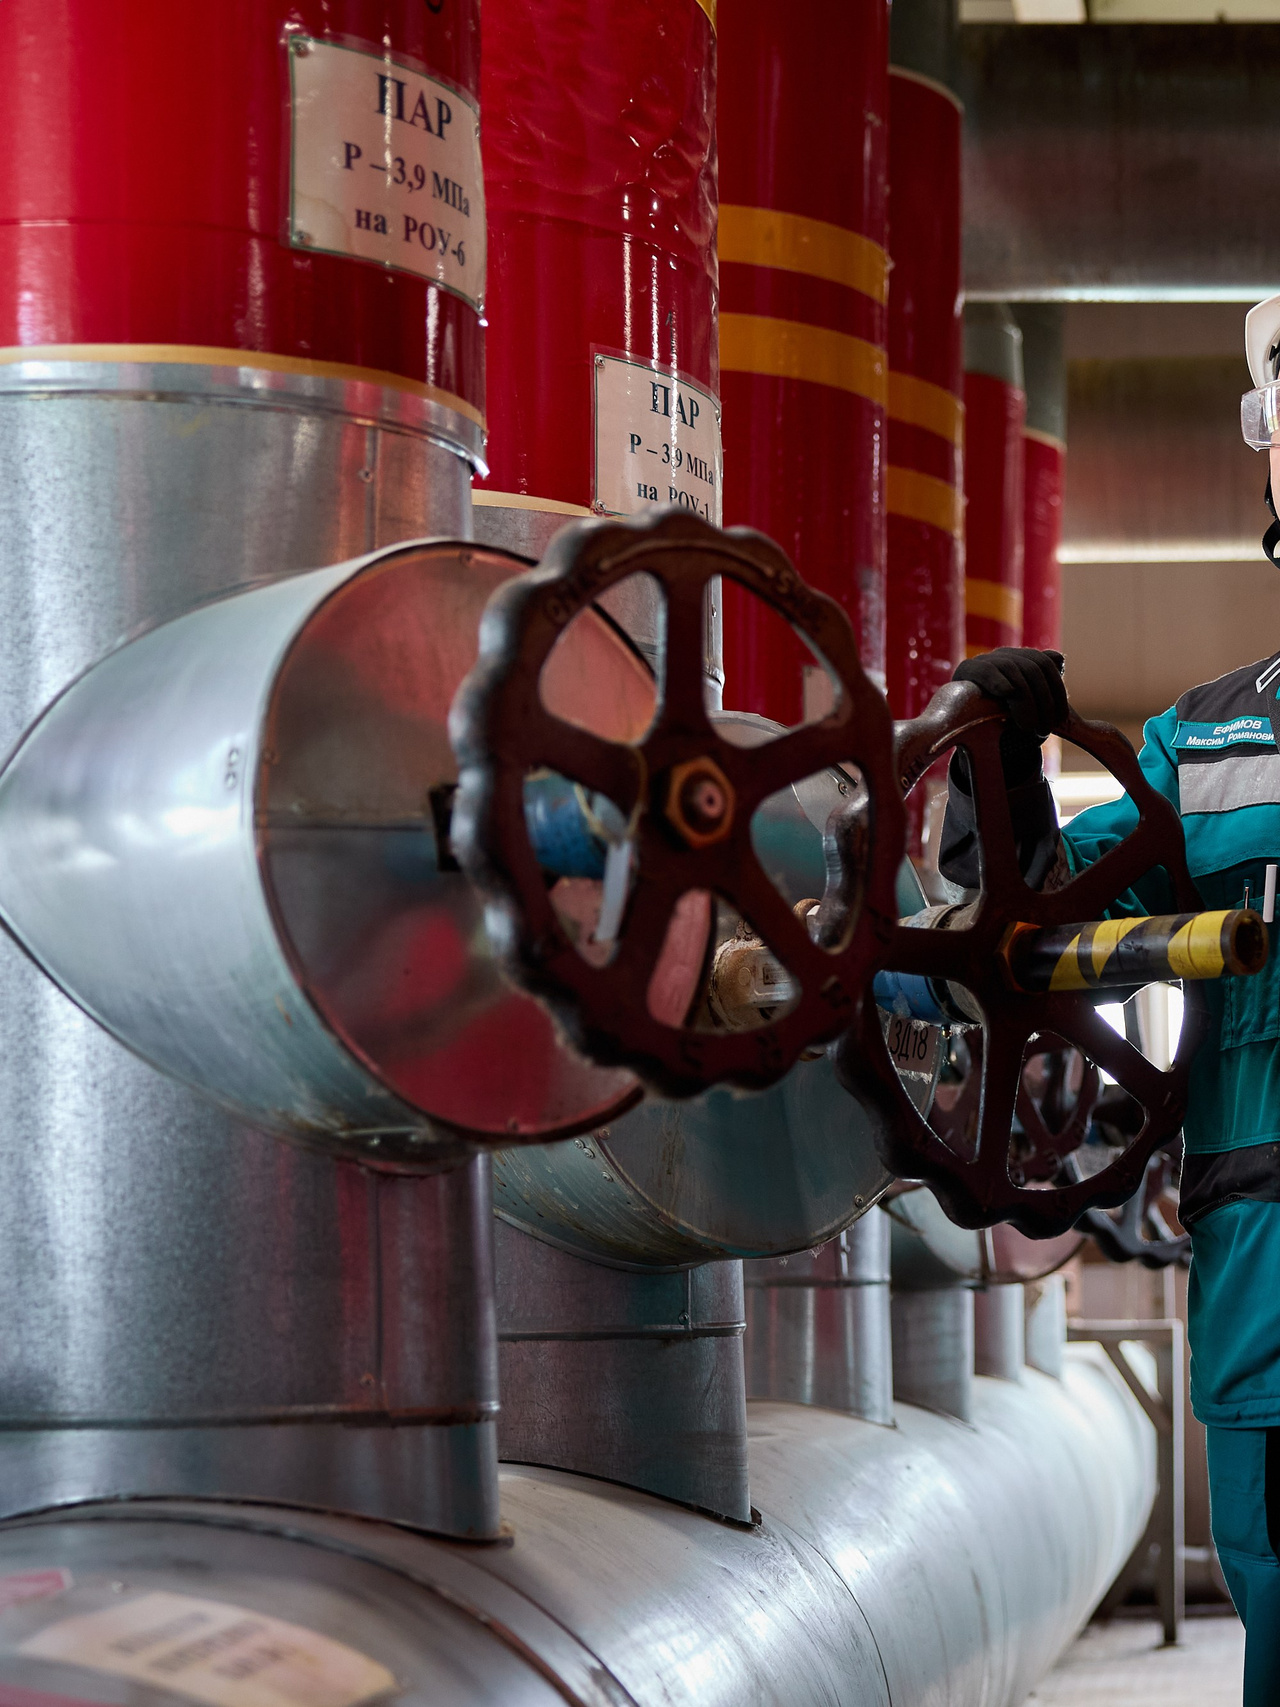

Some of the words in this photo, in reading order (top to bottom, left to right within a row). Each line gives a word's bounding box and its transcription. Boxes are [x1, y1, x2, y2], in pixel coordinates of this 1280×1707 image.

[374, 72, 452, 140] ПАР
[343, 141, 362, 171] Р
[392, 158, 426, 193] 3,9
[432, 171, 470, 218] МПа
[355, 208, 388, 235] на
[403, 214, 466, 266] РОУ-6
[650, 381, 700, 430] ПАР
[629, 433, 642, 454] Р
[662, 443, 683, 468] 39
[686, 453, 714, 485] МПа
[637, 482, 658, 501] на
[1186, 736, 1225, 746] Максим
[1227, 731, 1275, 743] Романови
[1213, 719, 1262, 735] ЕФИМОВ
